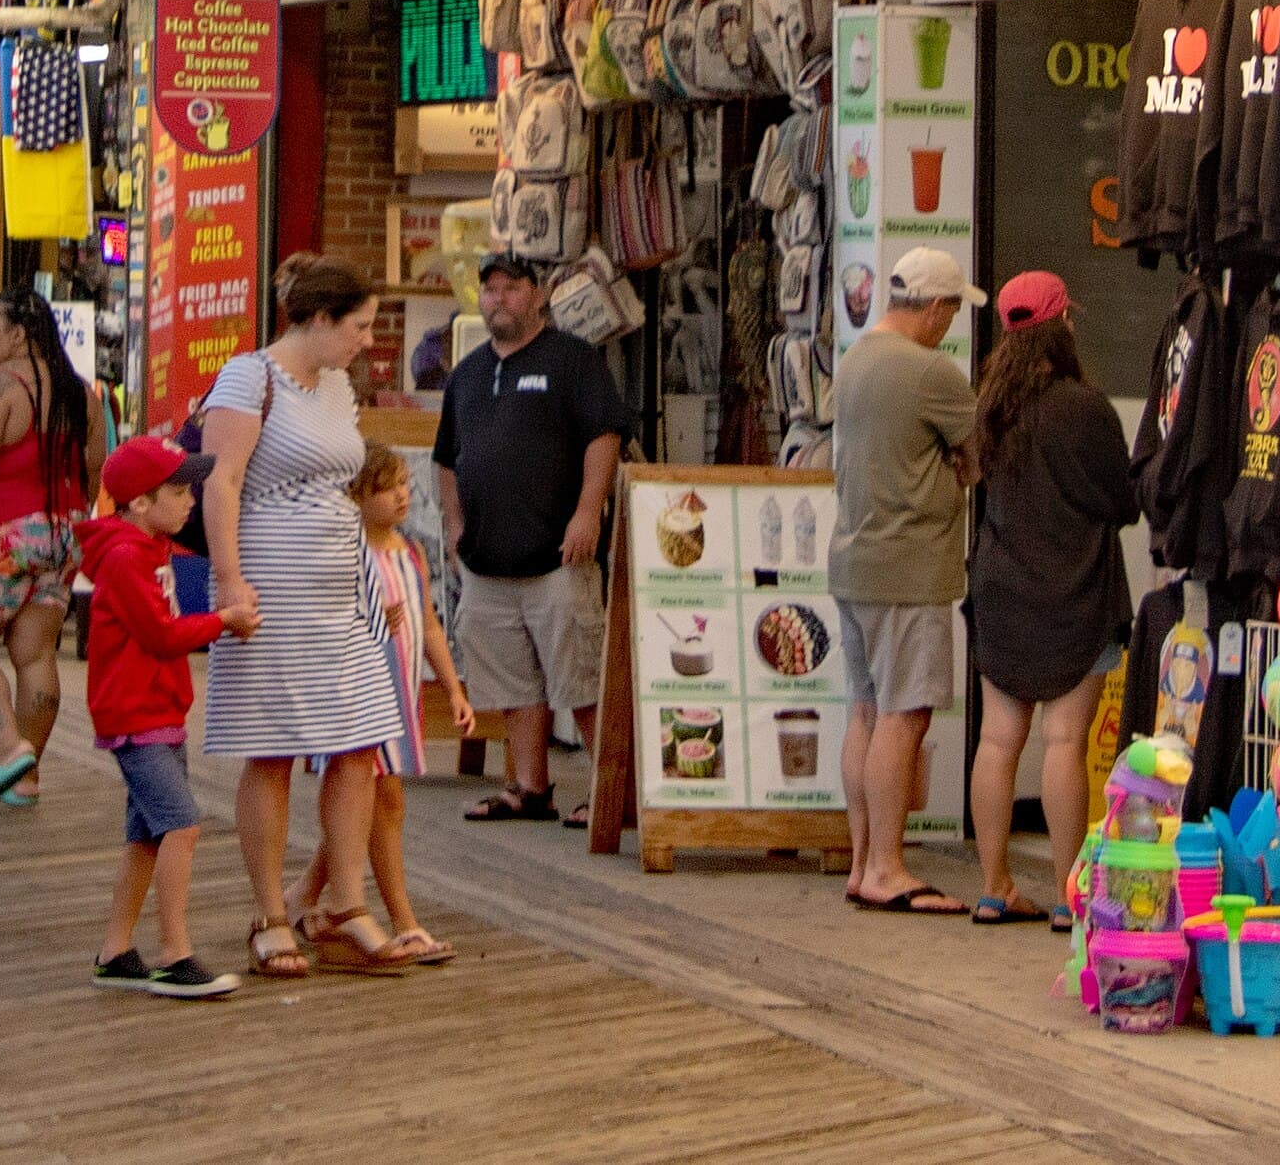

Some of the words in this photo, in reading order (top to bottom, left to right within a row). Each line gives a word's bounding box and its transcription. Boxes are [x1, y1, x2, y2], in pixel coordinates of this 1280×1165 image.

[193, 0, 242, 17] Coffee
[165, 17, 194, 34] Hot
[197, 18, 270, 36] Chocolate
[175, 35, 206, 52] Iced
[210, 36, 259, 54] Coffee
[185, 54, 249, 72] Espresso
[173, 72, 260, 92] Cappuccino
[892, 102, 928, 115] Sweet
[930, 102, 967, 116] Green
[187, 184, 246, 208] TENDERS
[195, 225, 234, 245] FRIED
[886, 221, 939, 235] Strawberry
[190, 242, 243, 265] PICKLES
[178, 283, 218, 304] FRIED
[220, 277, 250, 297] MAC
[197, 295, 247, 320] CHEESE
[187, 336, 239, 359] SHRIMP
